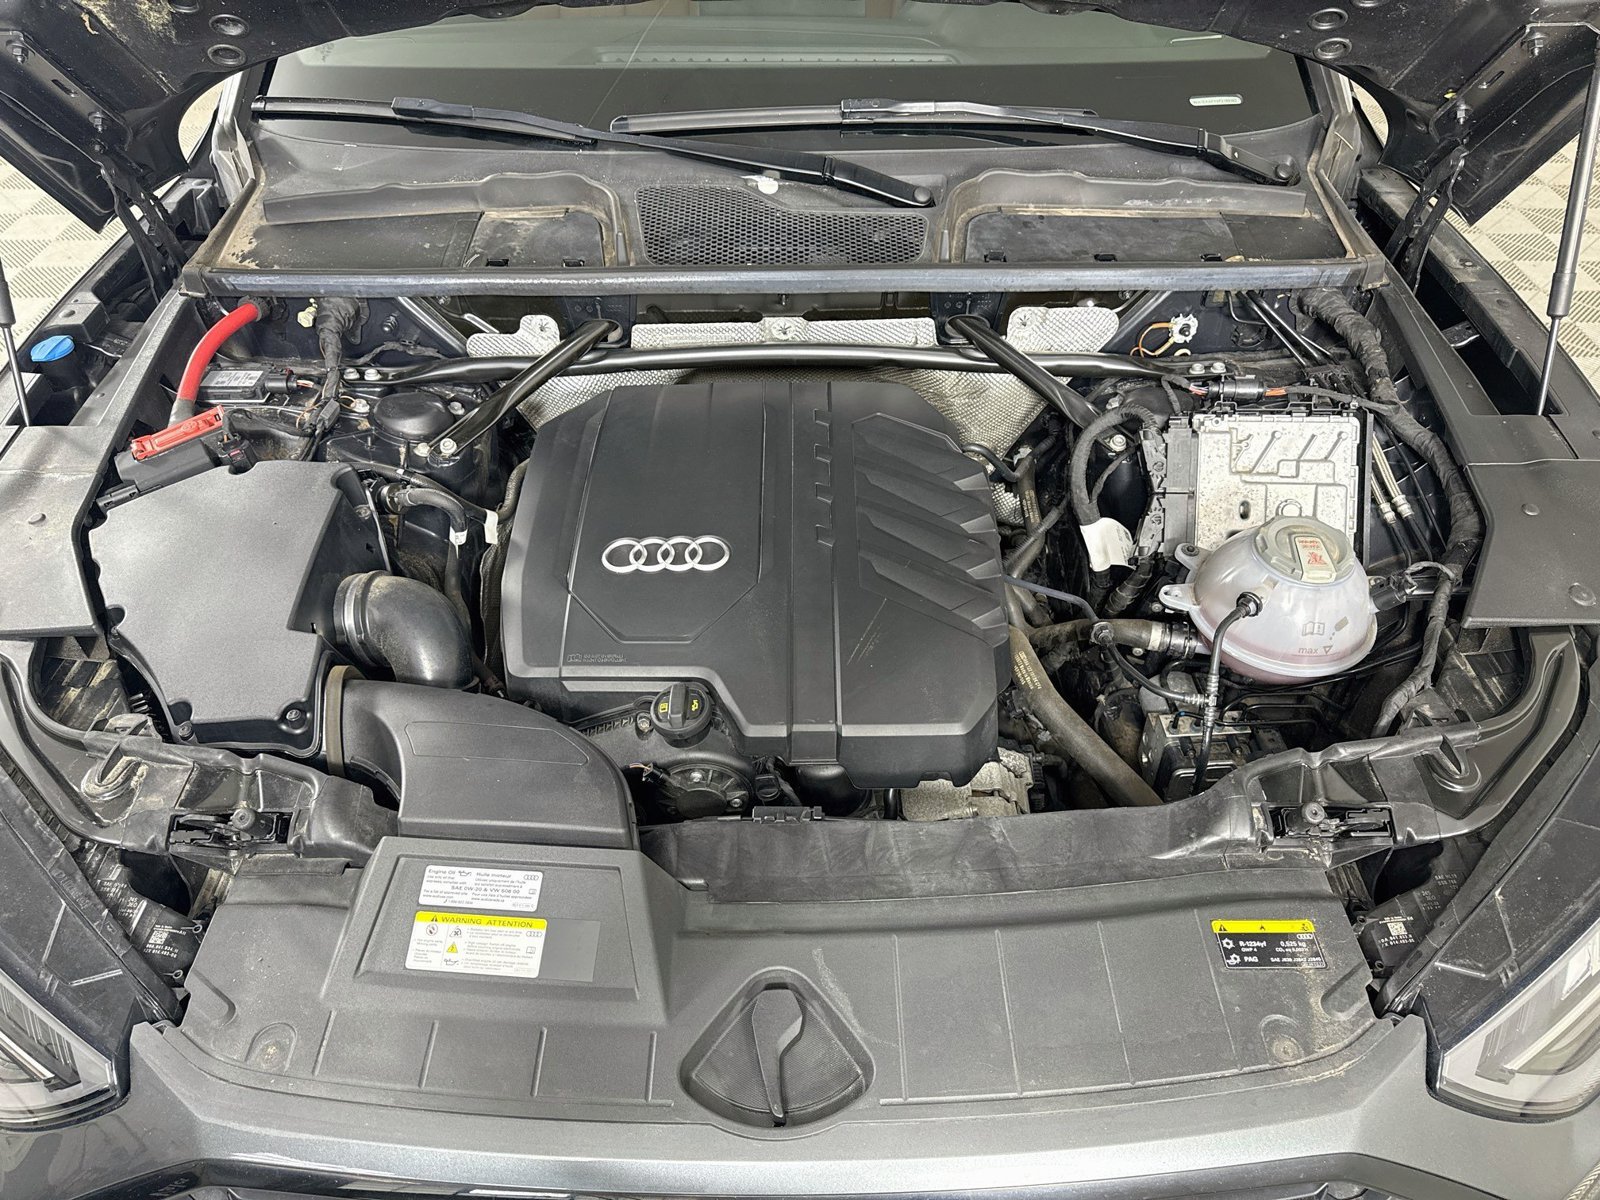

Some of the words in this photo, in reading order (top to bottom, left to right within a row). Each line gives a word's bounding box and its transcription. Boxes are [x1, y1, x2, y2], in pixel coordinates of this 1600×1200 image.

[1298, 647, 1319, 655] max
[441, 916, 482, 925] WARNING
[486, 919, 533, 929] ATTENTION
[1239, 940, 1267, 949] R-1234yf
[1280, 940, 1297, 948] 0,525
